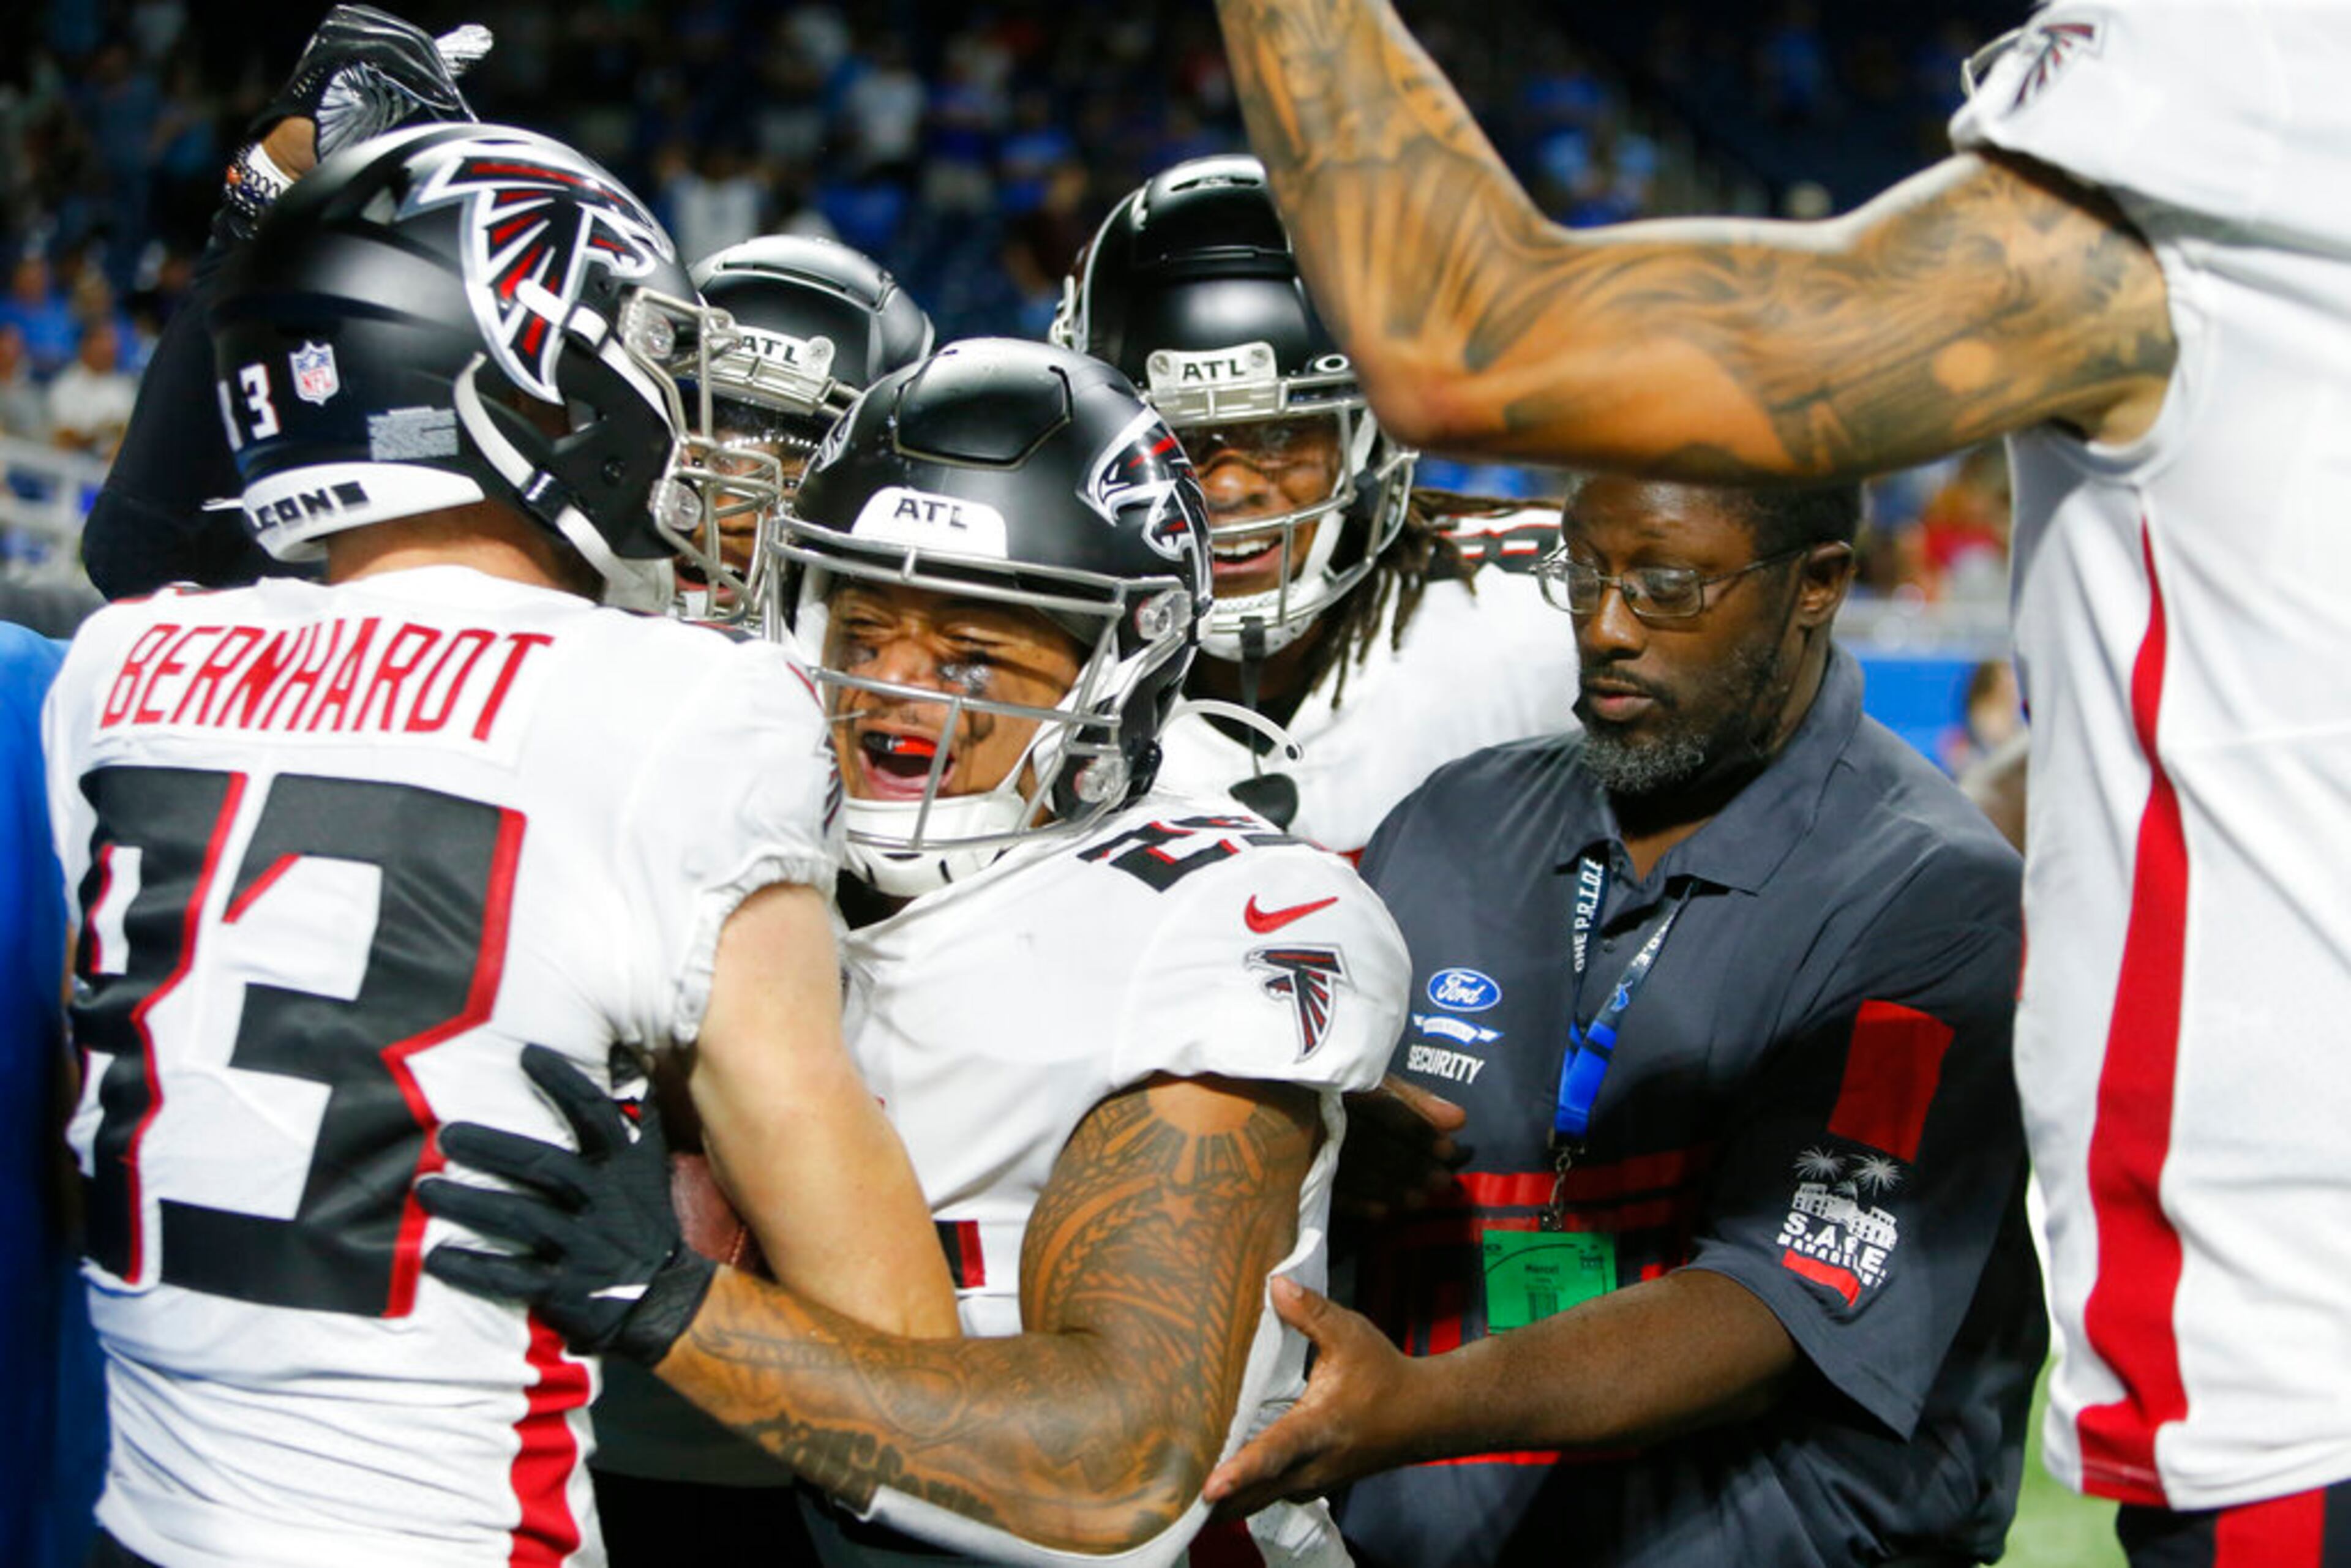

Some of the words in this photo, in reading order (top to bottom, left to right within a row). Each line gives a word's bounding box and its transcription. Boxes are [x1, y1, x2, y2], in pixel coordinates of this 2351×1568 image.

[741, 335, 798, 365] ATL
[1182, 358, 1245, 380] ATL
[894, 497, 967, 530] ATL
[100, 616, 555, 743] BERNHARDT
[1573, 932, 1588, 973] ONE
[1436, 973, 1487, 1005] Ford
[1407, 1045, 1485, 1085] SECURITY
